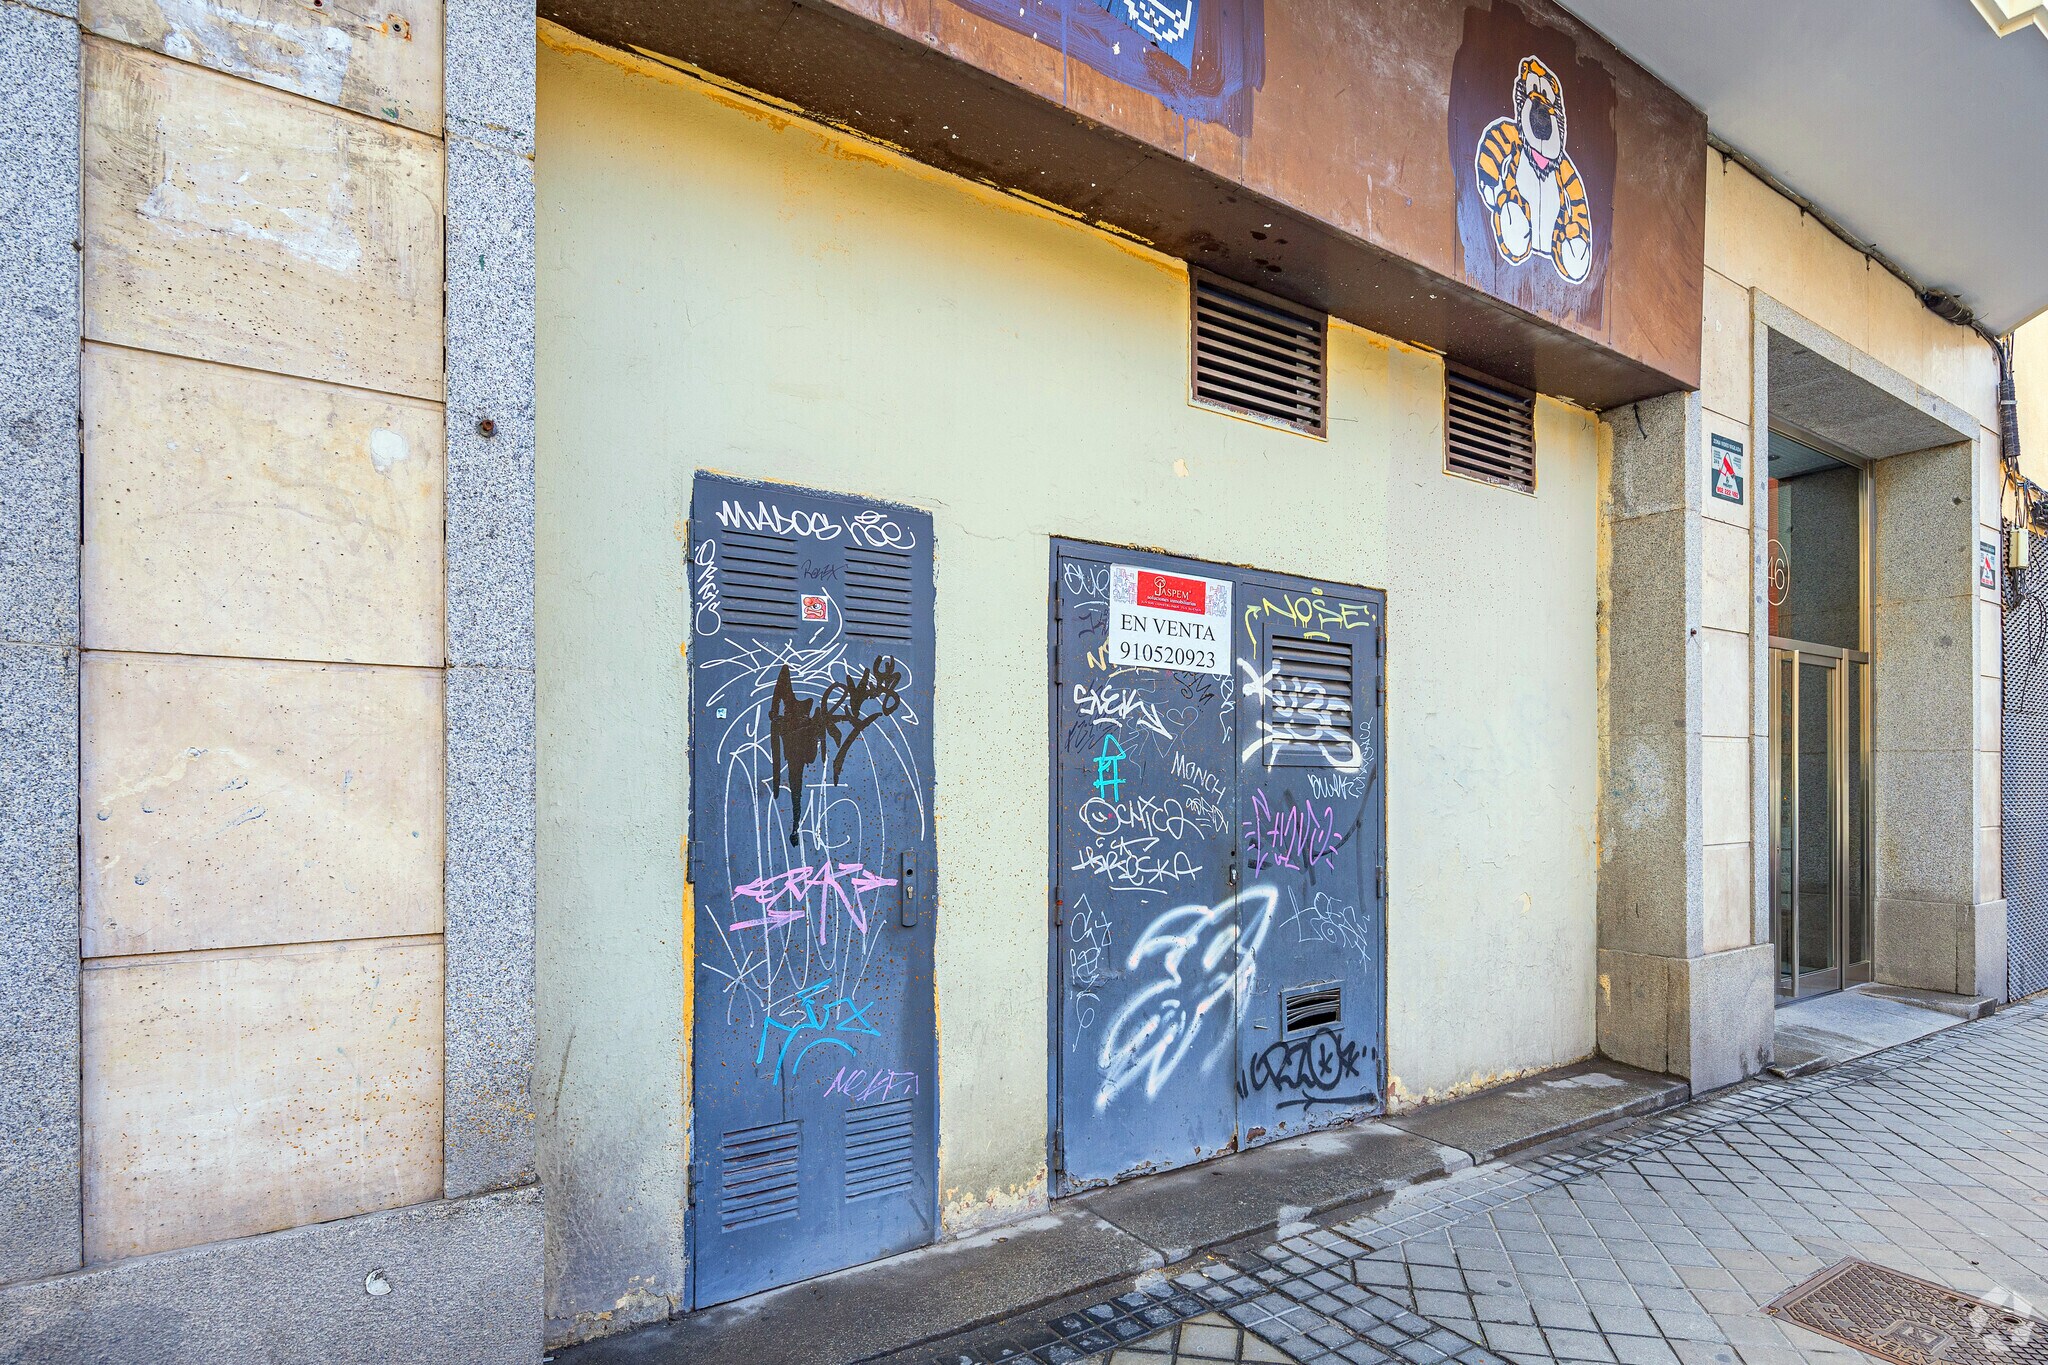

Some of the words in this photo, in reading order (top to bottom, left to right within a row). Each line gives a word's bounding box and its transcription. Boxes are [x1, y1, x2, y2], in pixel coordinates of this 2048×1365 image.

[1121, 614, 1147, 632] EN
[1152, 618, 1216, 641] VENTA
[1120, 641, 1215, 668] 910520923
